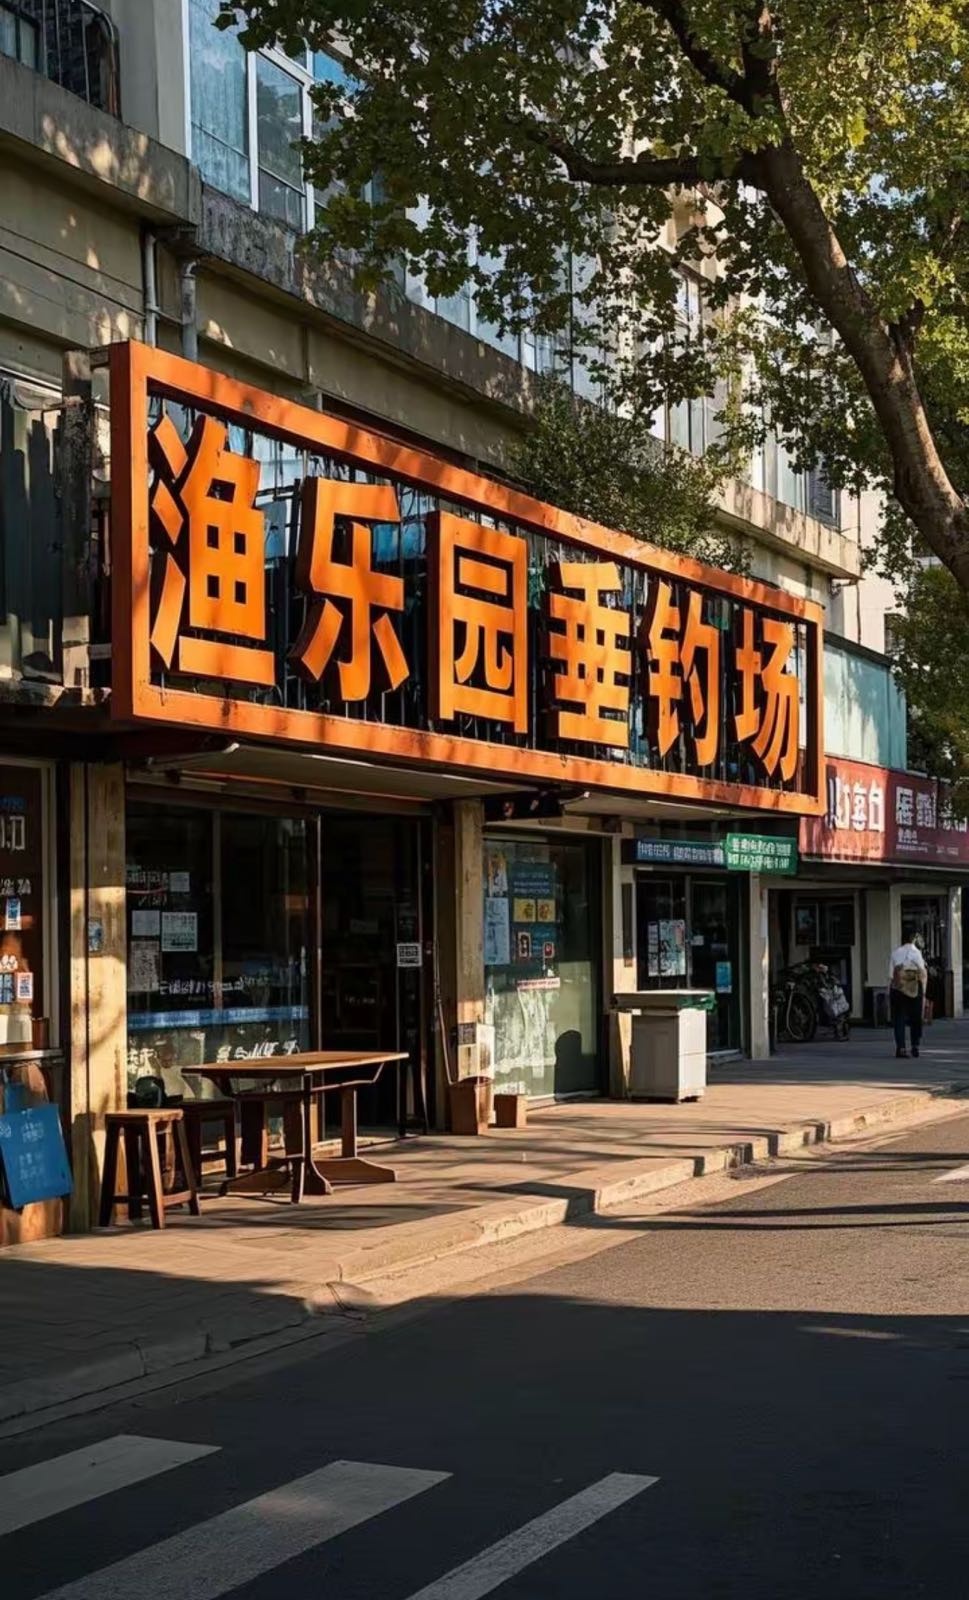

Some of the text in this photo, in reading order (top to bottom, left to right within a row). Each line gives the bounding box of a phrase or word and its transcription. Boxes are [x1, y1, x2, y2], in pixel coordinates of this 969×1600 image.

[150, 413, 798, 782] 渔乐园垂钓场
